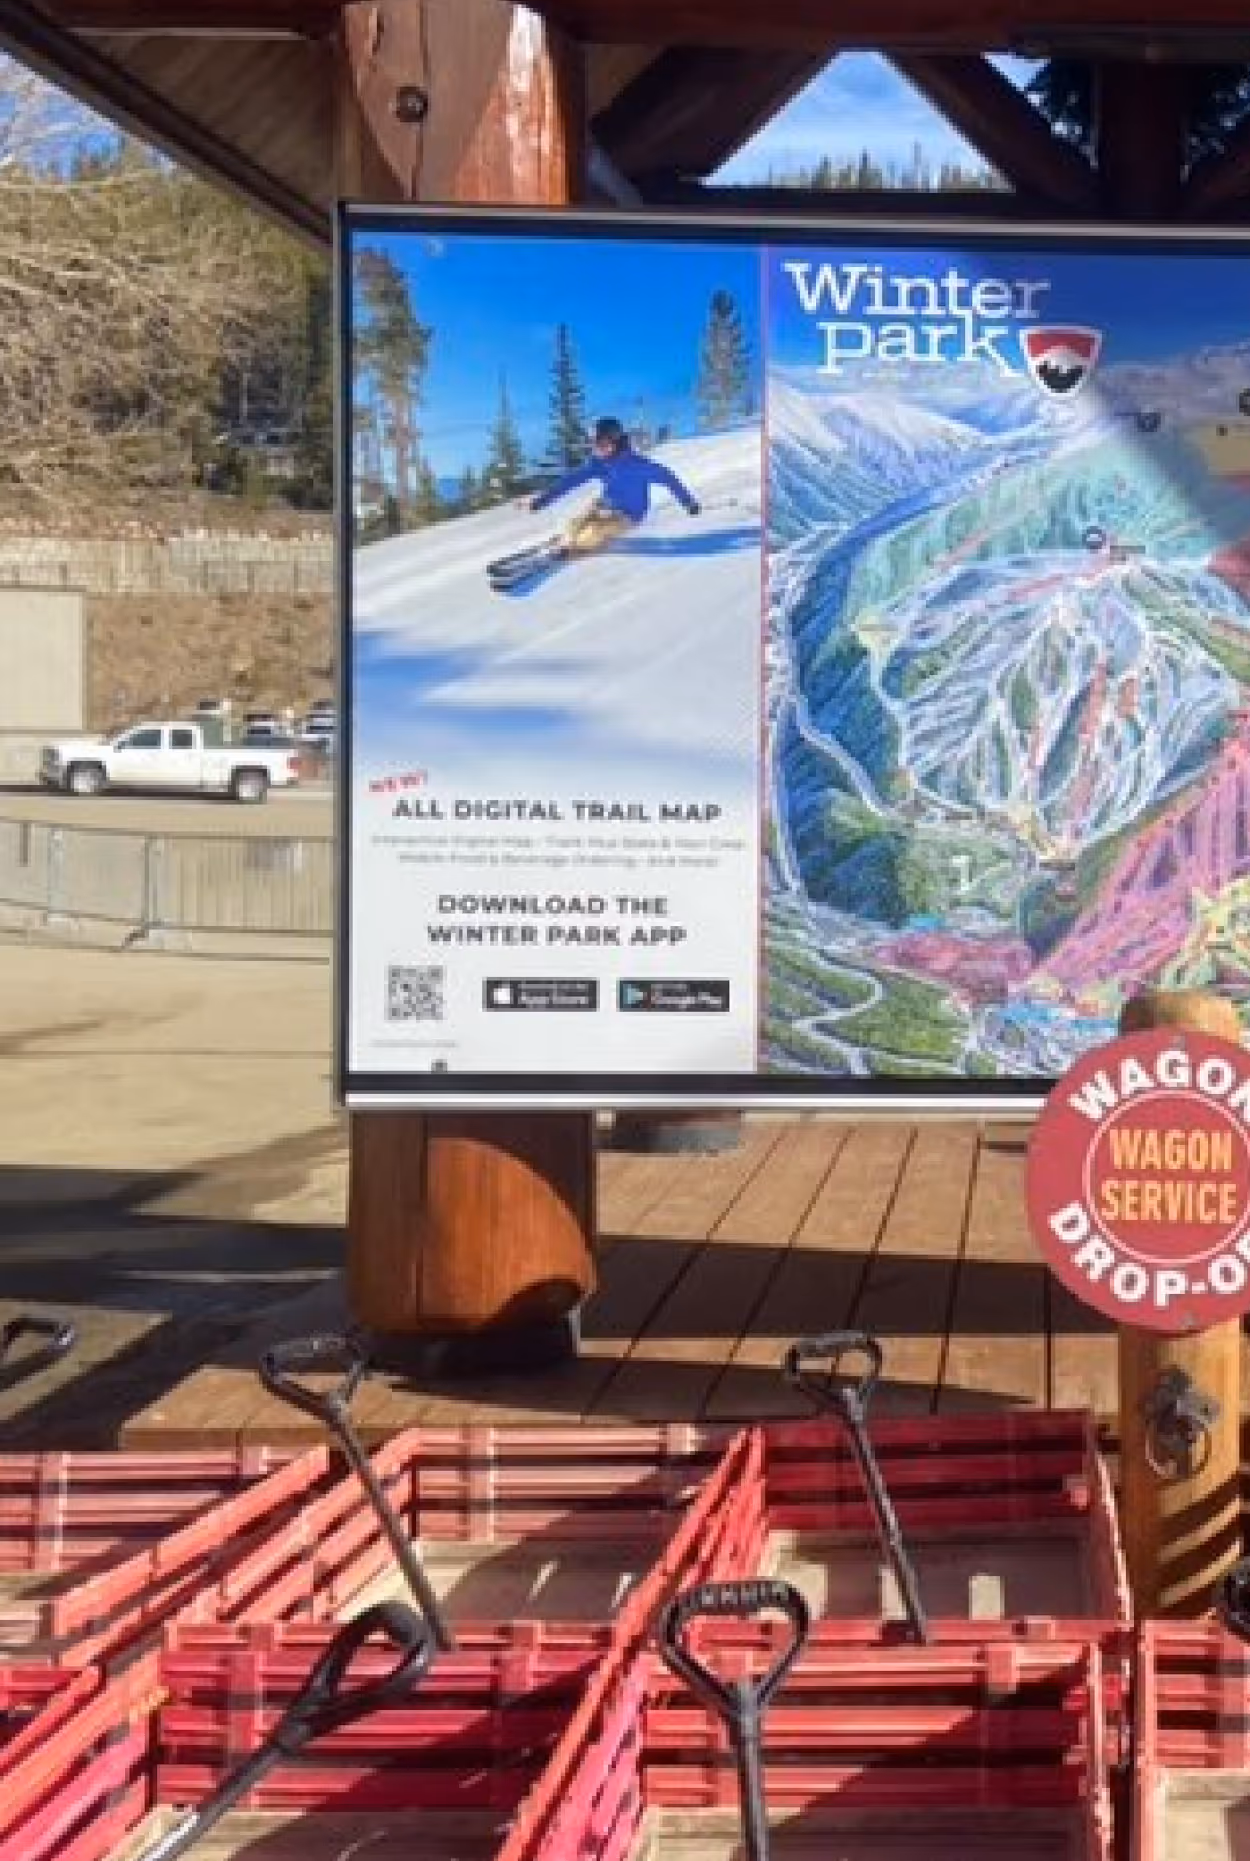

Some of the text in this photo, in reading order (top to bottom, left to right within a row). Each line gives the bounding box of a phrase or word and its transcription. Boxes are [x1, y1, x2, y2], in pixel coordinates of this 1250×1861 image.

[782, 262, 1051, 318] Winter
[392, 798, 723, 824] ALL DIGITAL TRAIL MAP
[436, 894, 669, 917] DOWNLOAD THE
[427, 925, 689, 947] WINTER PARK APP
[1108, 1128, 1233, 1173] WAGON
[1100, 1180, 1238, 1225] SERVICE
